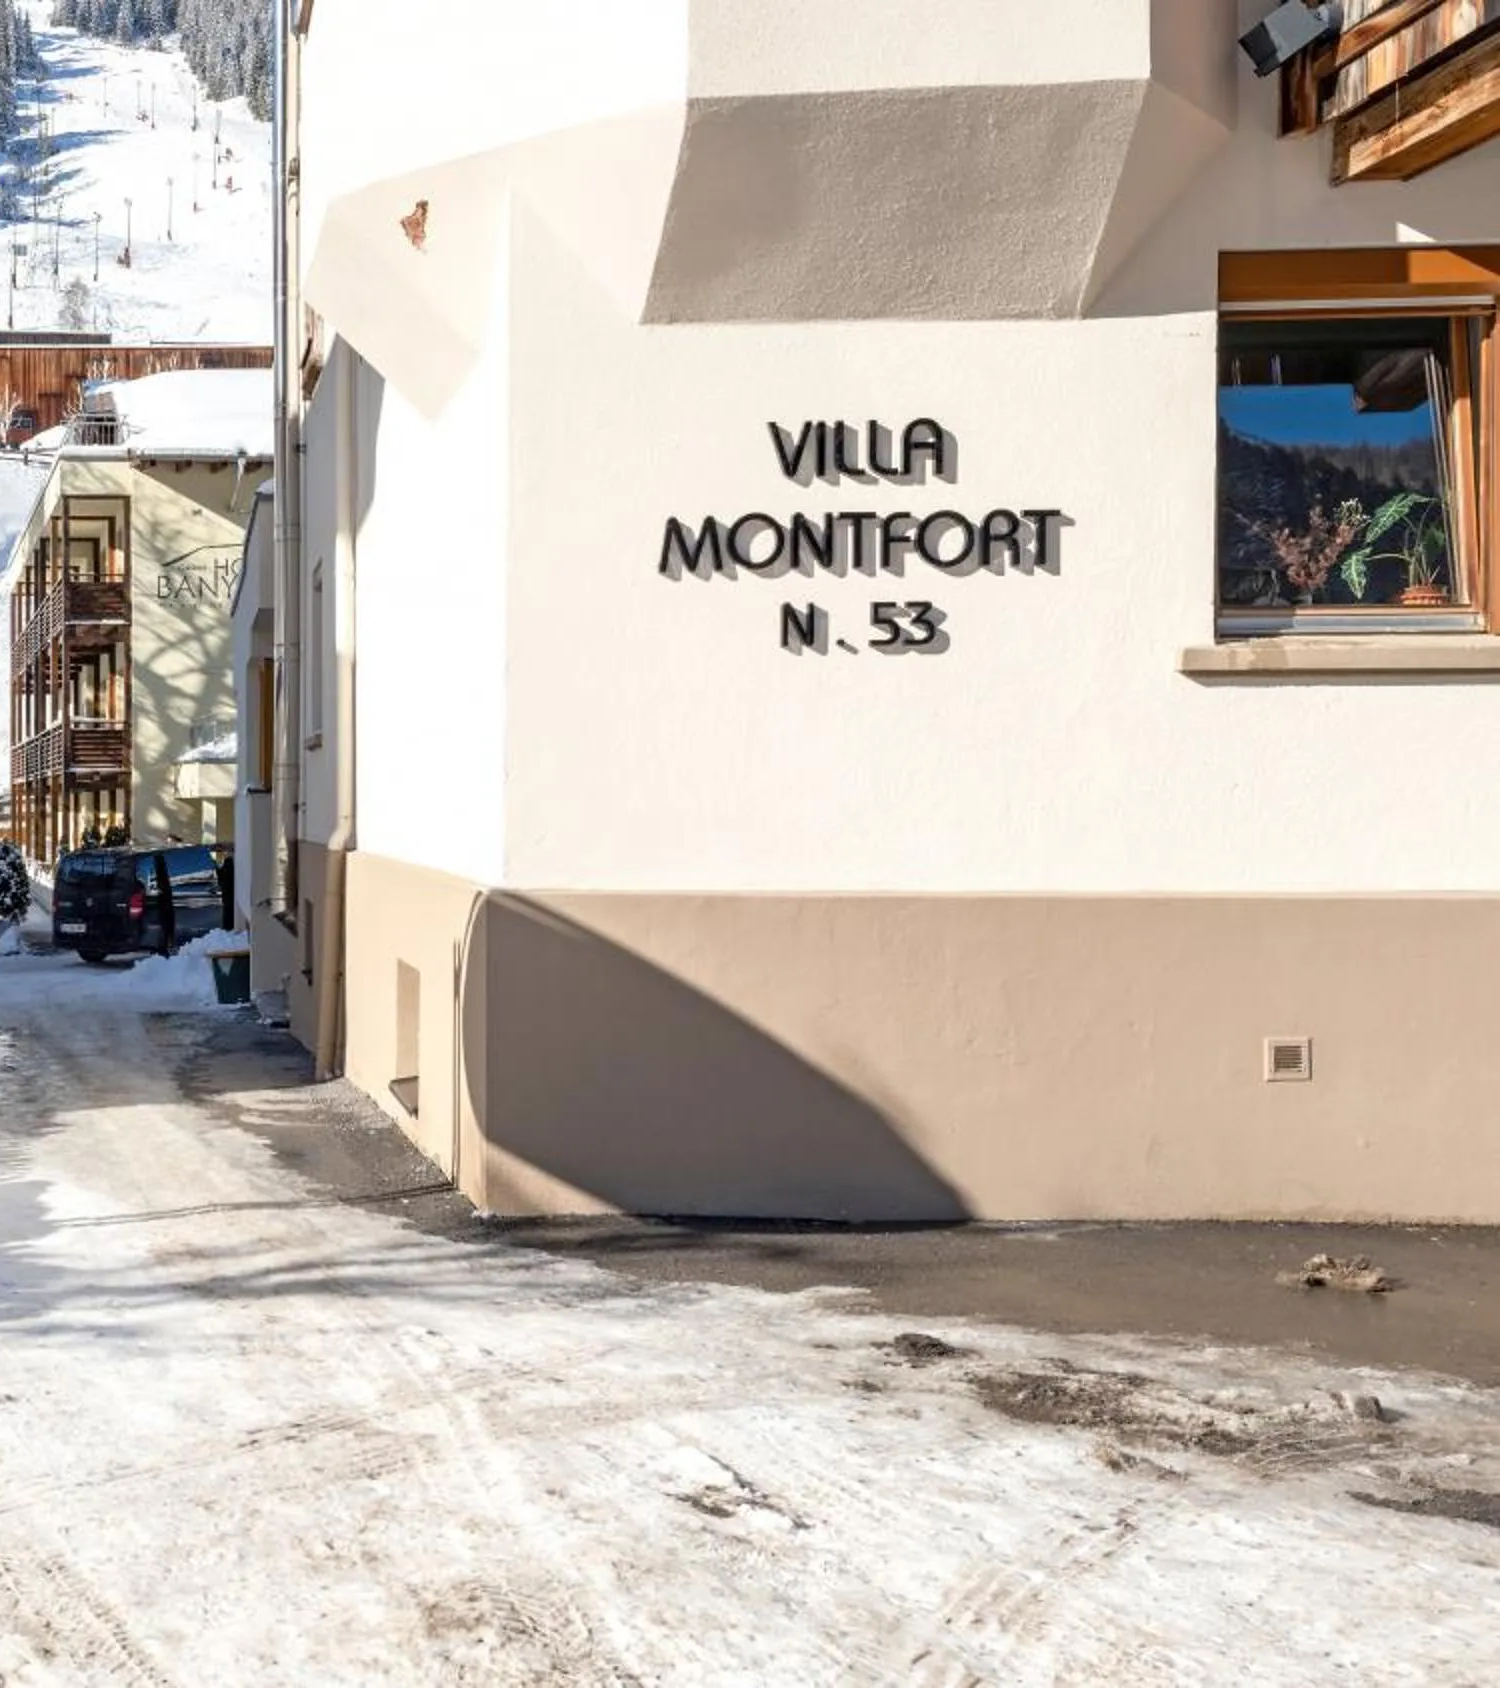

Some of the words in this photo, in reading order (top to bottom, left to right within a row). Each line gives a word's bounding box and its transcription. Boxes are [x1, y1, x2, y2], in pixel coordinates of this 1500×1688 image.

[767, 418, 944, 477] VILLA
[658, 508, 1063, 574] MONTFORT
[868, 601, 936, 648] 53
